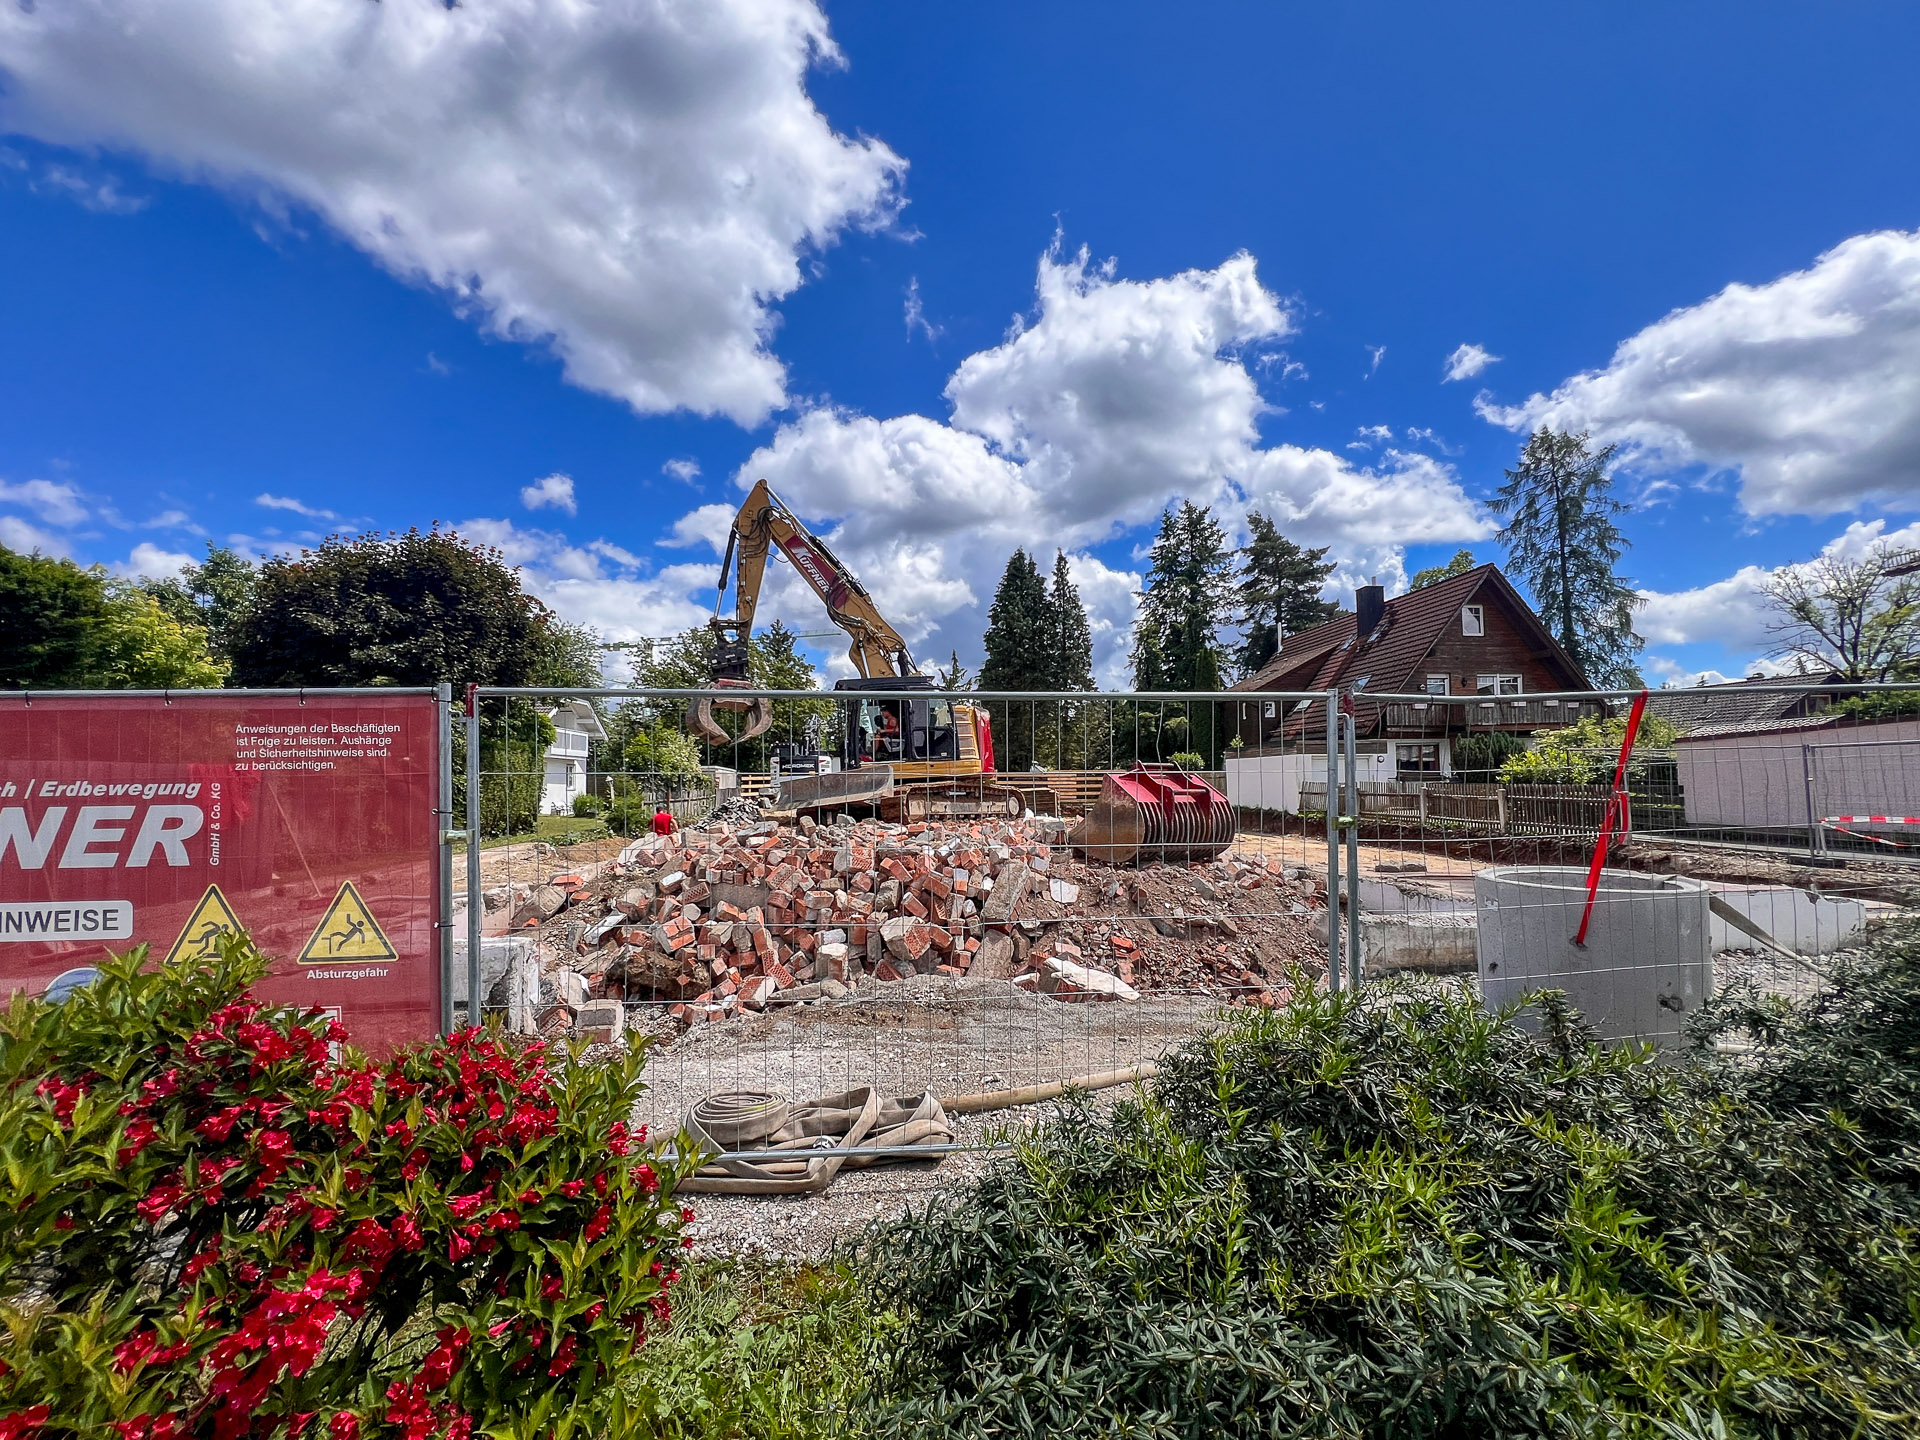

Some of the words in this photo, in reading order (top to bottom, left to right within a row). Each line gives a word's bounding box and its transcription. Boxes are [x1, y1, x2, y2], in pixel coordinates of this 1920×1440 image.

[235, 724, 307, 735] Anweisungen
[309, 723, 329, 733] der
[331, 723, 401, 735] Beschäftigten
[236, 736, 249, 746] ist
[251, 736, 281, 748] Folge
[283, 738, 297, 746] zu
[299, 735, 338, 746] leisten.
[340, 735, 392, 747] Aushänge
[236, 748, 256, 759] und
[259, 747, 364, 758] Sicherheitshinweise
[366, 747, 387, 757] sind
[235, 763, 249, 771] zu
[252, 760, 337, 772] berücksichtigen.
[39, 781, 202, 799] Erdbewegung
[211, 783, 221, 799] KG
[211, 802, 221, 820] Co.
[211, 822, 220, 830] &
[210, 833, 220, 866] GmbH
[307, 968, 389, 980] Absturzgefahr
